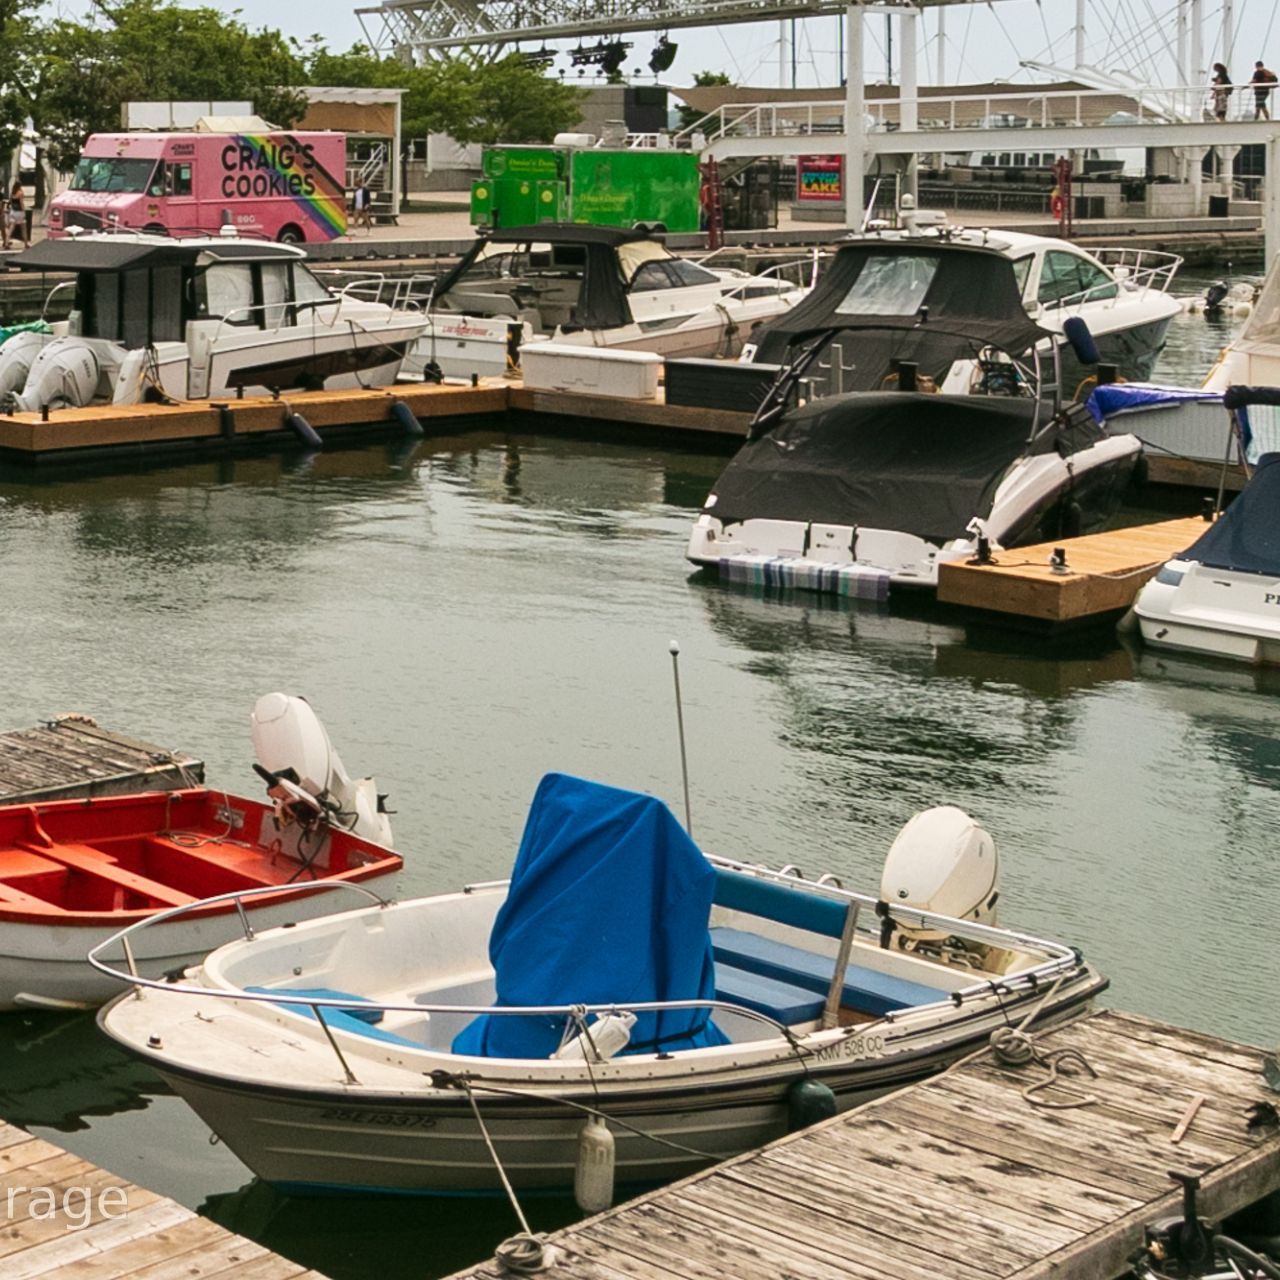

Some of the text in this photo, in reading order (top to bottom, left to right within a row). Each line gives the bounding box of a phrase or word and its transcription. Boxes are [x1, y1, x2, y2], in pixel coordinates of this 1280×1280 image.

[221, 144, 315, 171] CRAIG'S
[844, 1039, 864, 1057] 528
[866, 1036, 883, 1052] CC
